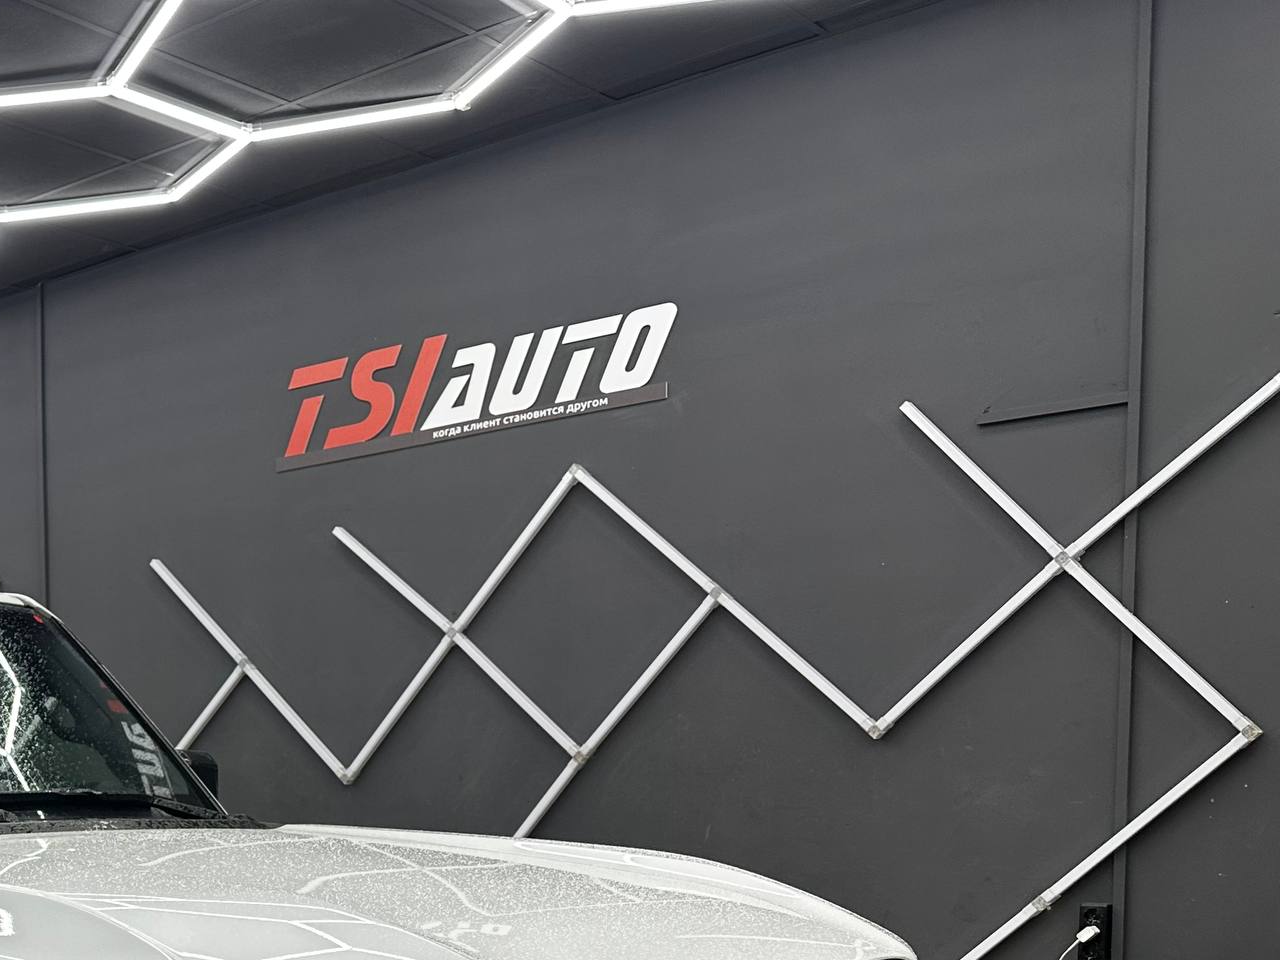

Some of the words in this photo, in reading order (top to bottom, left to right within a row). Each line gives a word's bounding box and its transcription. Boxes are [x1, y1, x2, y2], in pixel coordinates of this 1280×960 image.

[431, 424, 463, 440] когда
[463, 417, 502, 433] клиент
[503, 405, 565, 425] становится
[566, 397, 609, 416] другом
